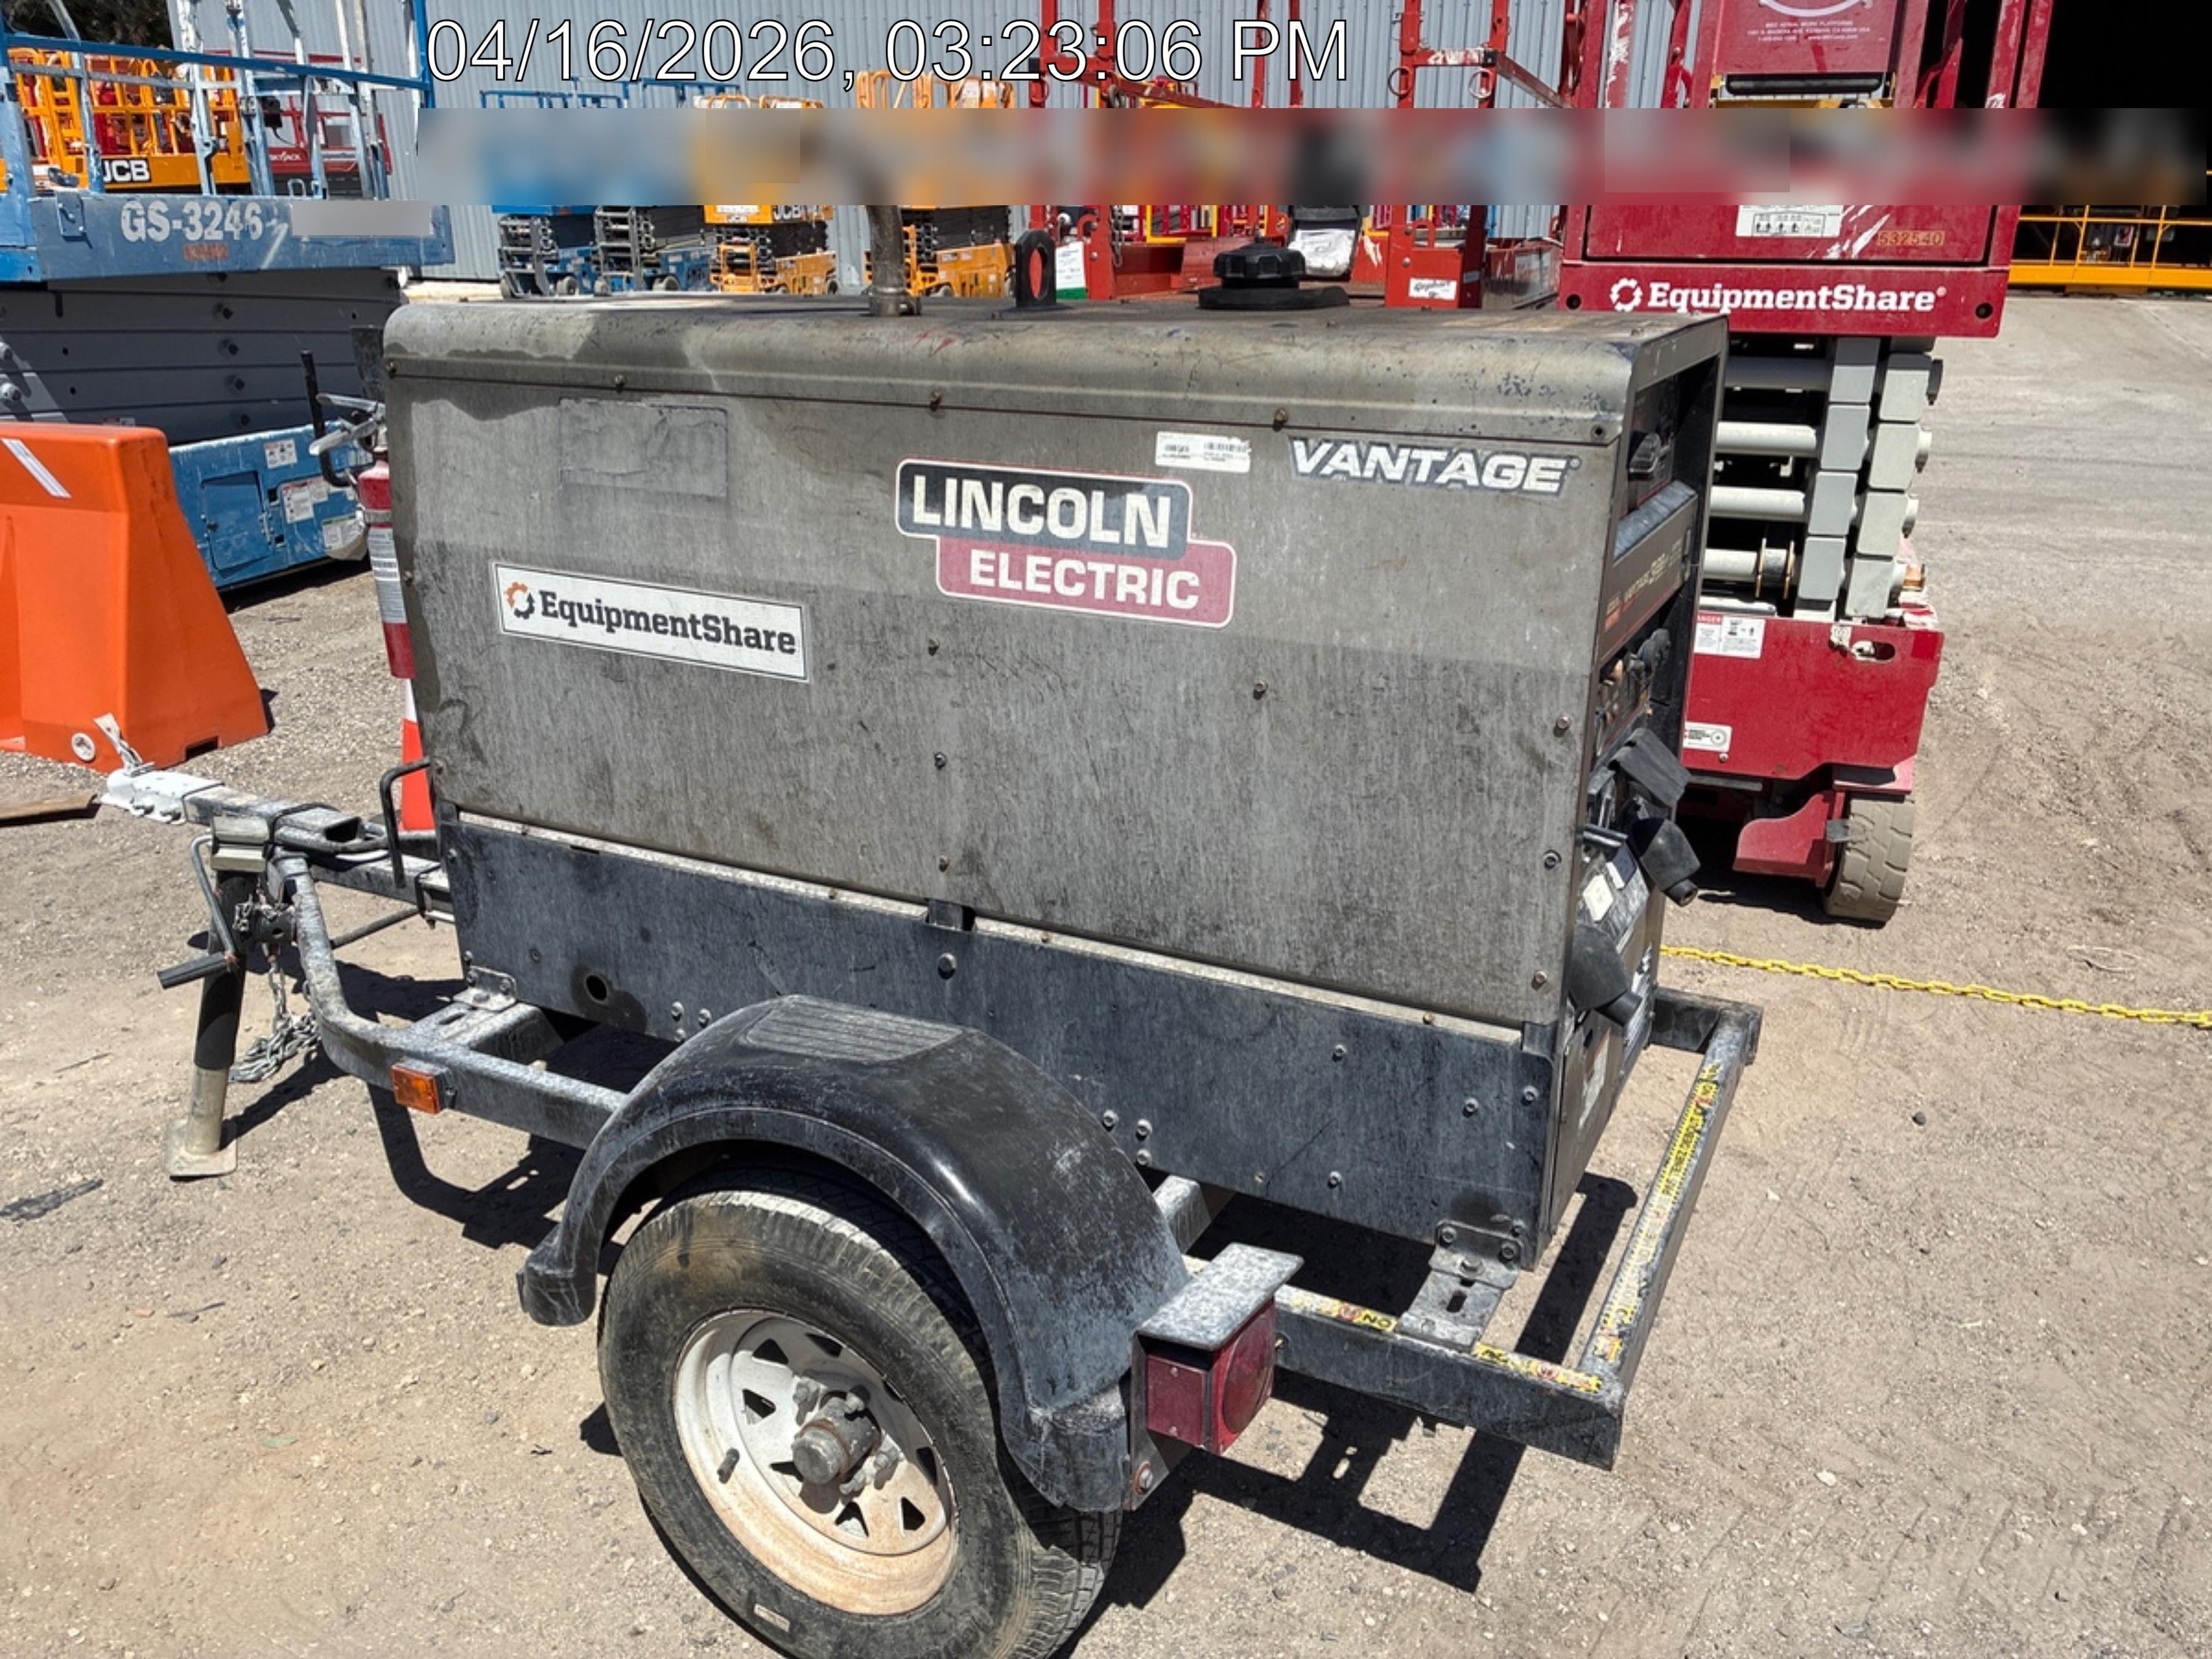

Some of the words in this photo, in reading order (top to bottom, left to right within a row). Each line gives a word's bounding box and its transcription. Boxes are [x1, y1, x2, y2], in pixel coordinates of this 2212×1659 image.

[103, 160, 150, 181] JCB
[121, 200, 263, 241] GS-3246
[1293, 441, 1568, 493] VANTAGE
[914, 475, 1171, 549] LINCOLN
[970, 549, 1200, 610] ELECTRIC
[539, 590, 796, 655] EquipmentShare
